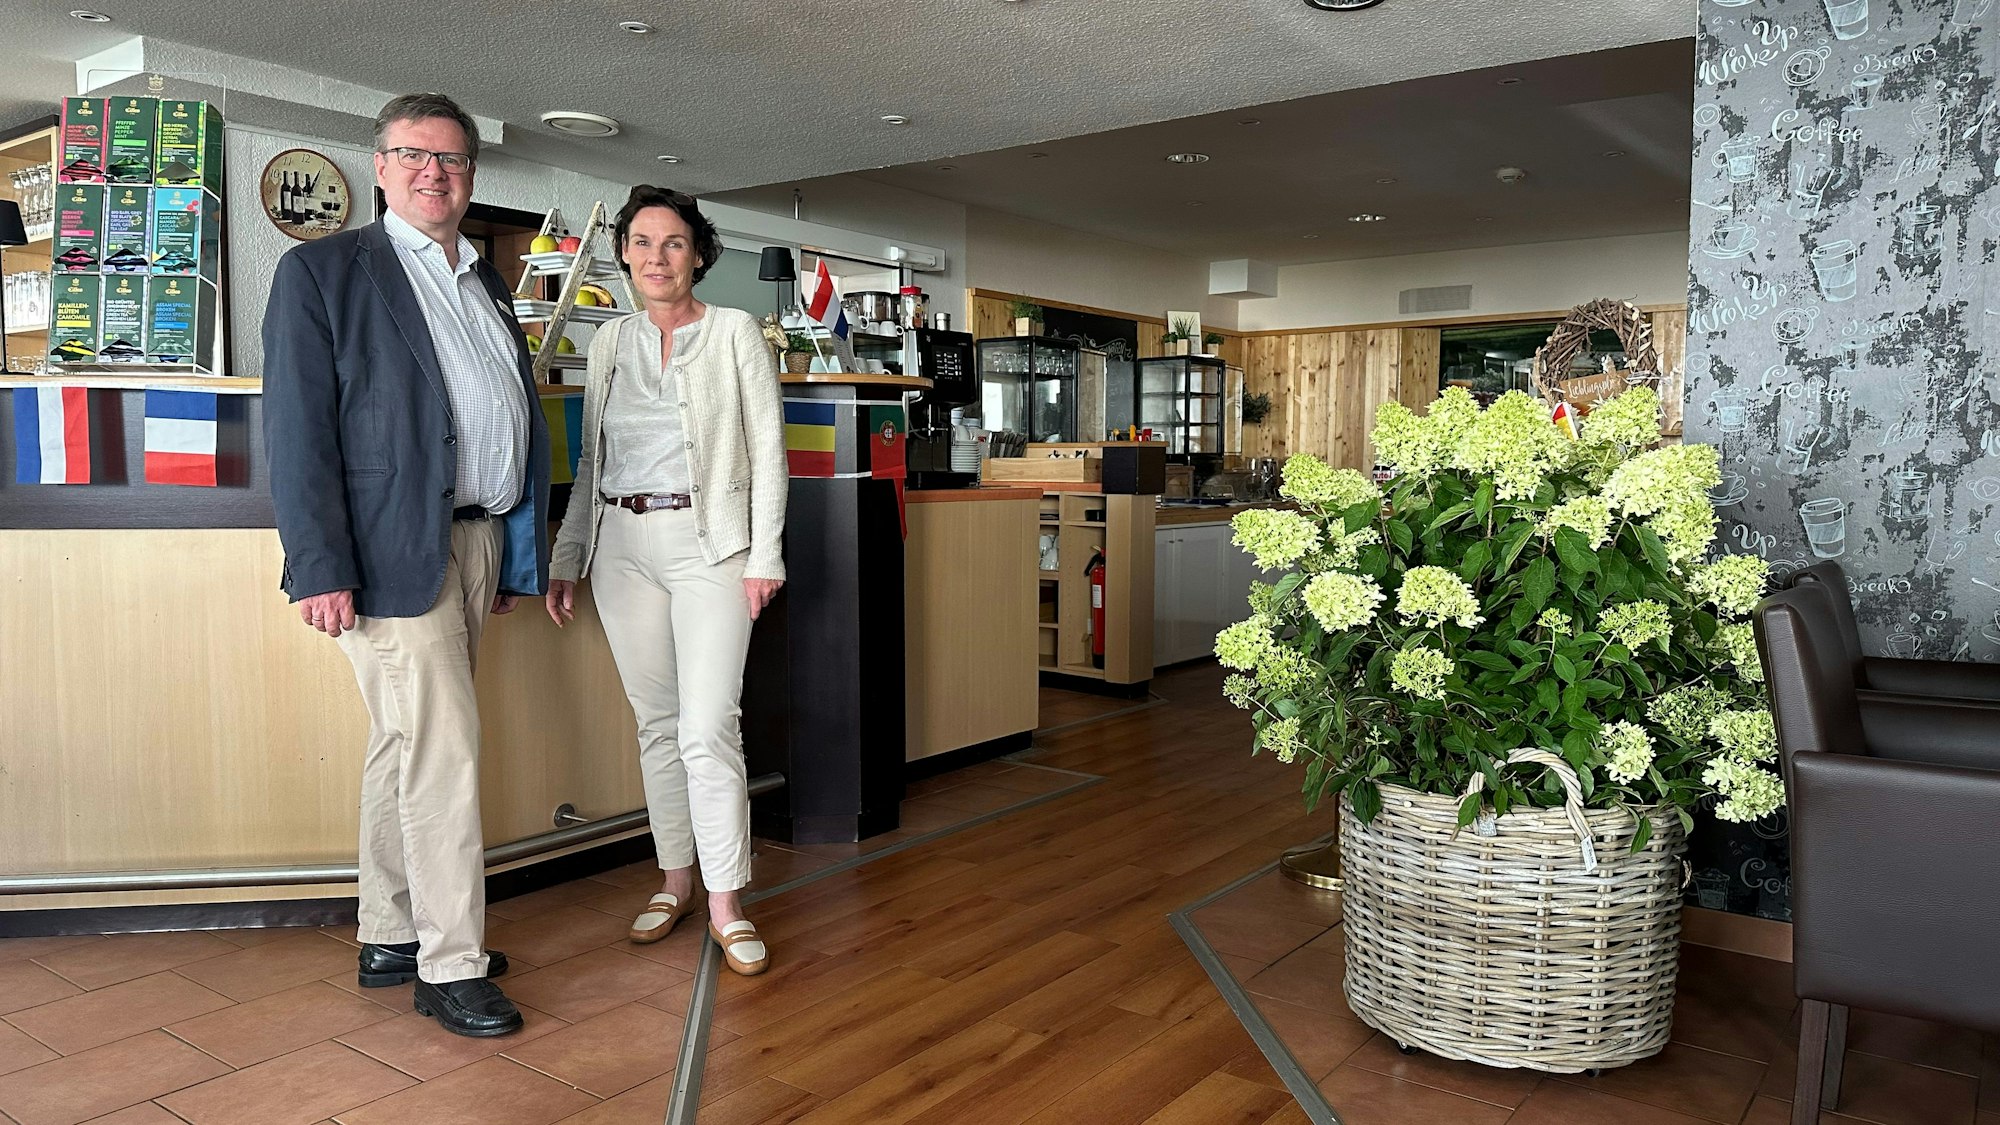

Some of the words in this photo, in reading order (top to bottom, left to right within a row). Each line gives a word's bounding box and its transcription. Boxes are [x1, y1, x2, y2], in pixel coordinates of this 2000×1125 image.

[1752, 20, 1798, 51] Up
[1853, 48, 1936, 73] Break
[1771, 108, 1863, 145] Coffee
[1742, 275, 1787, 308] Up
[1567, 375, 1617, 398] Lieblingspl
[1761, 364, 1851, 403] Coffee
[1731, 524, 1777, 558] Up
[1740, 857, 1791, 896] Cof
